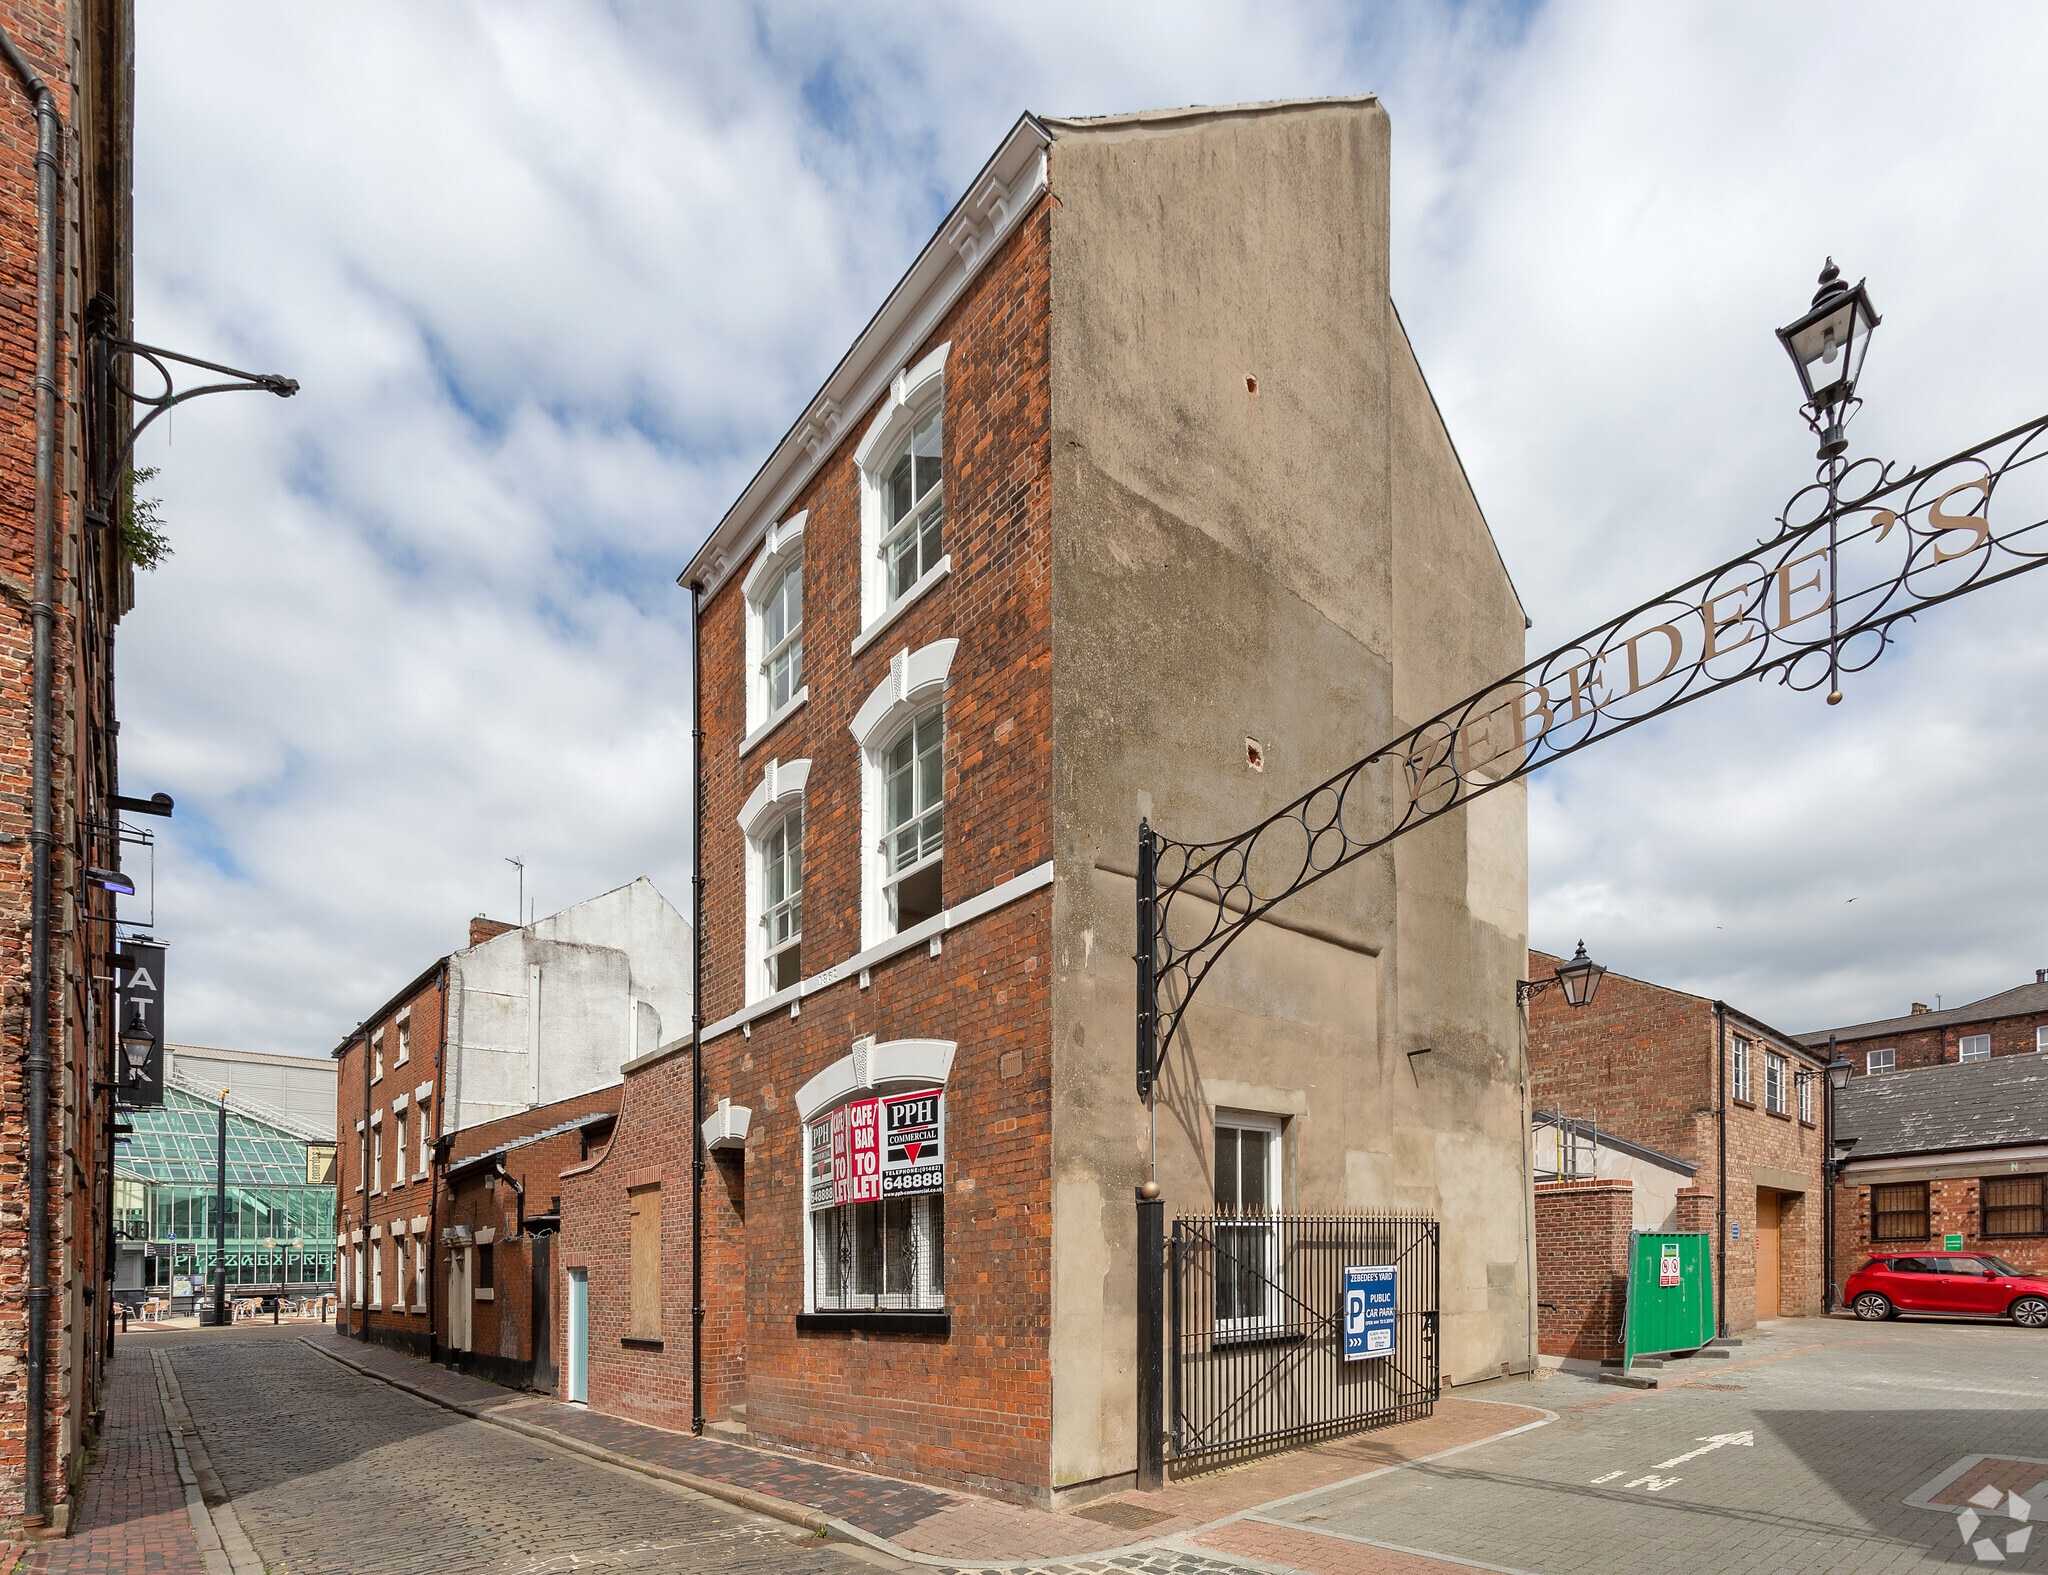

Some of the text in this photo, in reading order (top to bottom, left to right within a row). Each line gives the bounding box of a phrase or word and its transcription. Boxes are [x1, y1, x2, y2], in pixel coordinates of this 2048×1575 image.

[1402, 473, 1989, 803] ZEBEDEE'S
[892, 1100, 933, 1127] PPH
[813, 1122, 830, 1148] PPH
[854, 1127, 875, 1150] BAR
[889, 1130, 937, 1144] COMMERCIAL
[835, 1156, 846, 1180] TO
[855, 1151, 876, 1176] TO
[834, 1178, 848, 1204] LET
[853, 1174, 879, 1199] LET
[883, 1171, 943, 1190] 648888
[811, 1187, 834, 1204] 648888
[1350, 1272, 1393, 1282] ZEBEDEE'S YARD
[1370, 1293, 1391, 1303] PUBLIC
[1350, 1297, 1363, 1329] P
[1366, 1307, 1394, 1318] CAR PARK
